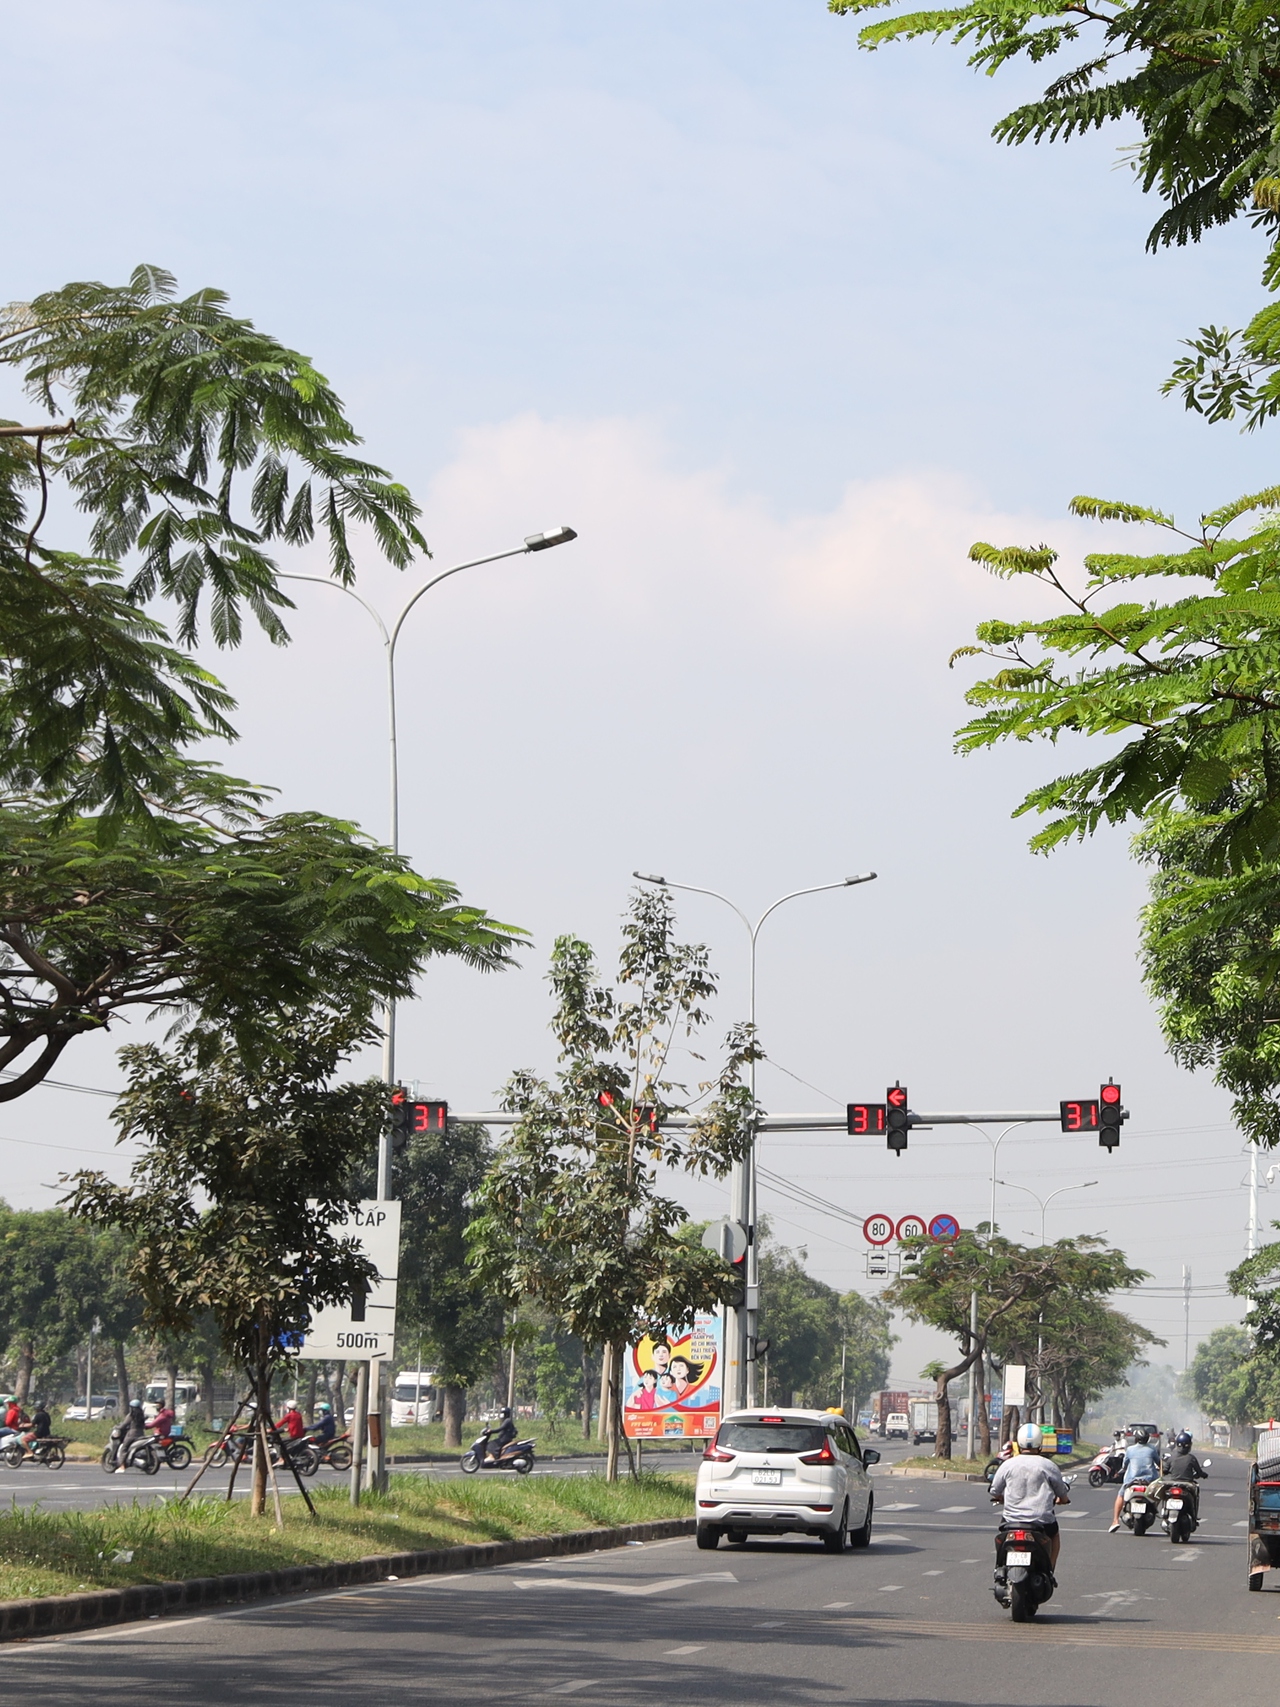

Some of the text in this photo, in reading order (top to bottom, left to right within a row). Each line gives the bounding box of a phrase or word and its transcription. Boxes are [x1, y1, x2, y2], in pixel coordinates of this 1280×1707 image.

[414, 1104, 444, 1131] 31
[854, 1106, 884, 1132] 31
[1067, 1103, 1097, 1129] 31
[356, 1206, 386, 1227] CẤP
[872, 1223, 886, 1236] 80
[905, 1224, 918, 1237] 60
[337, 1333, 378, 1348] 500m
